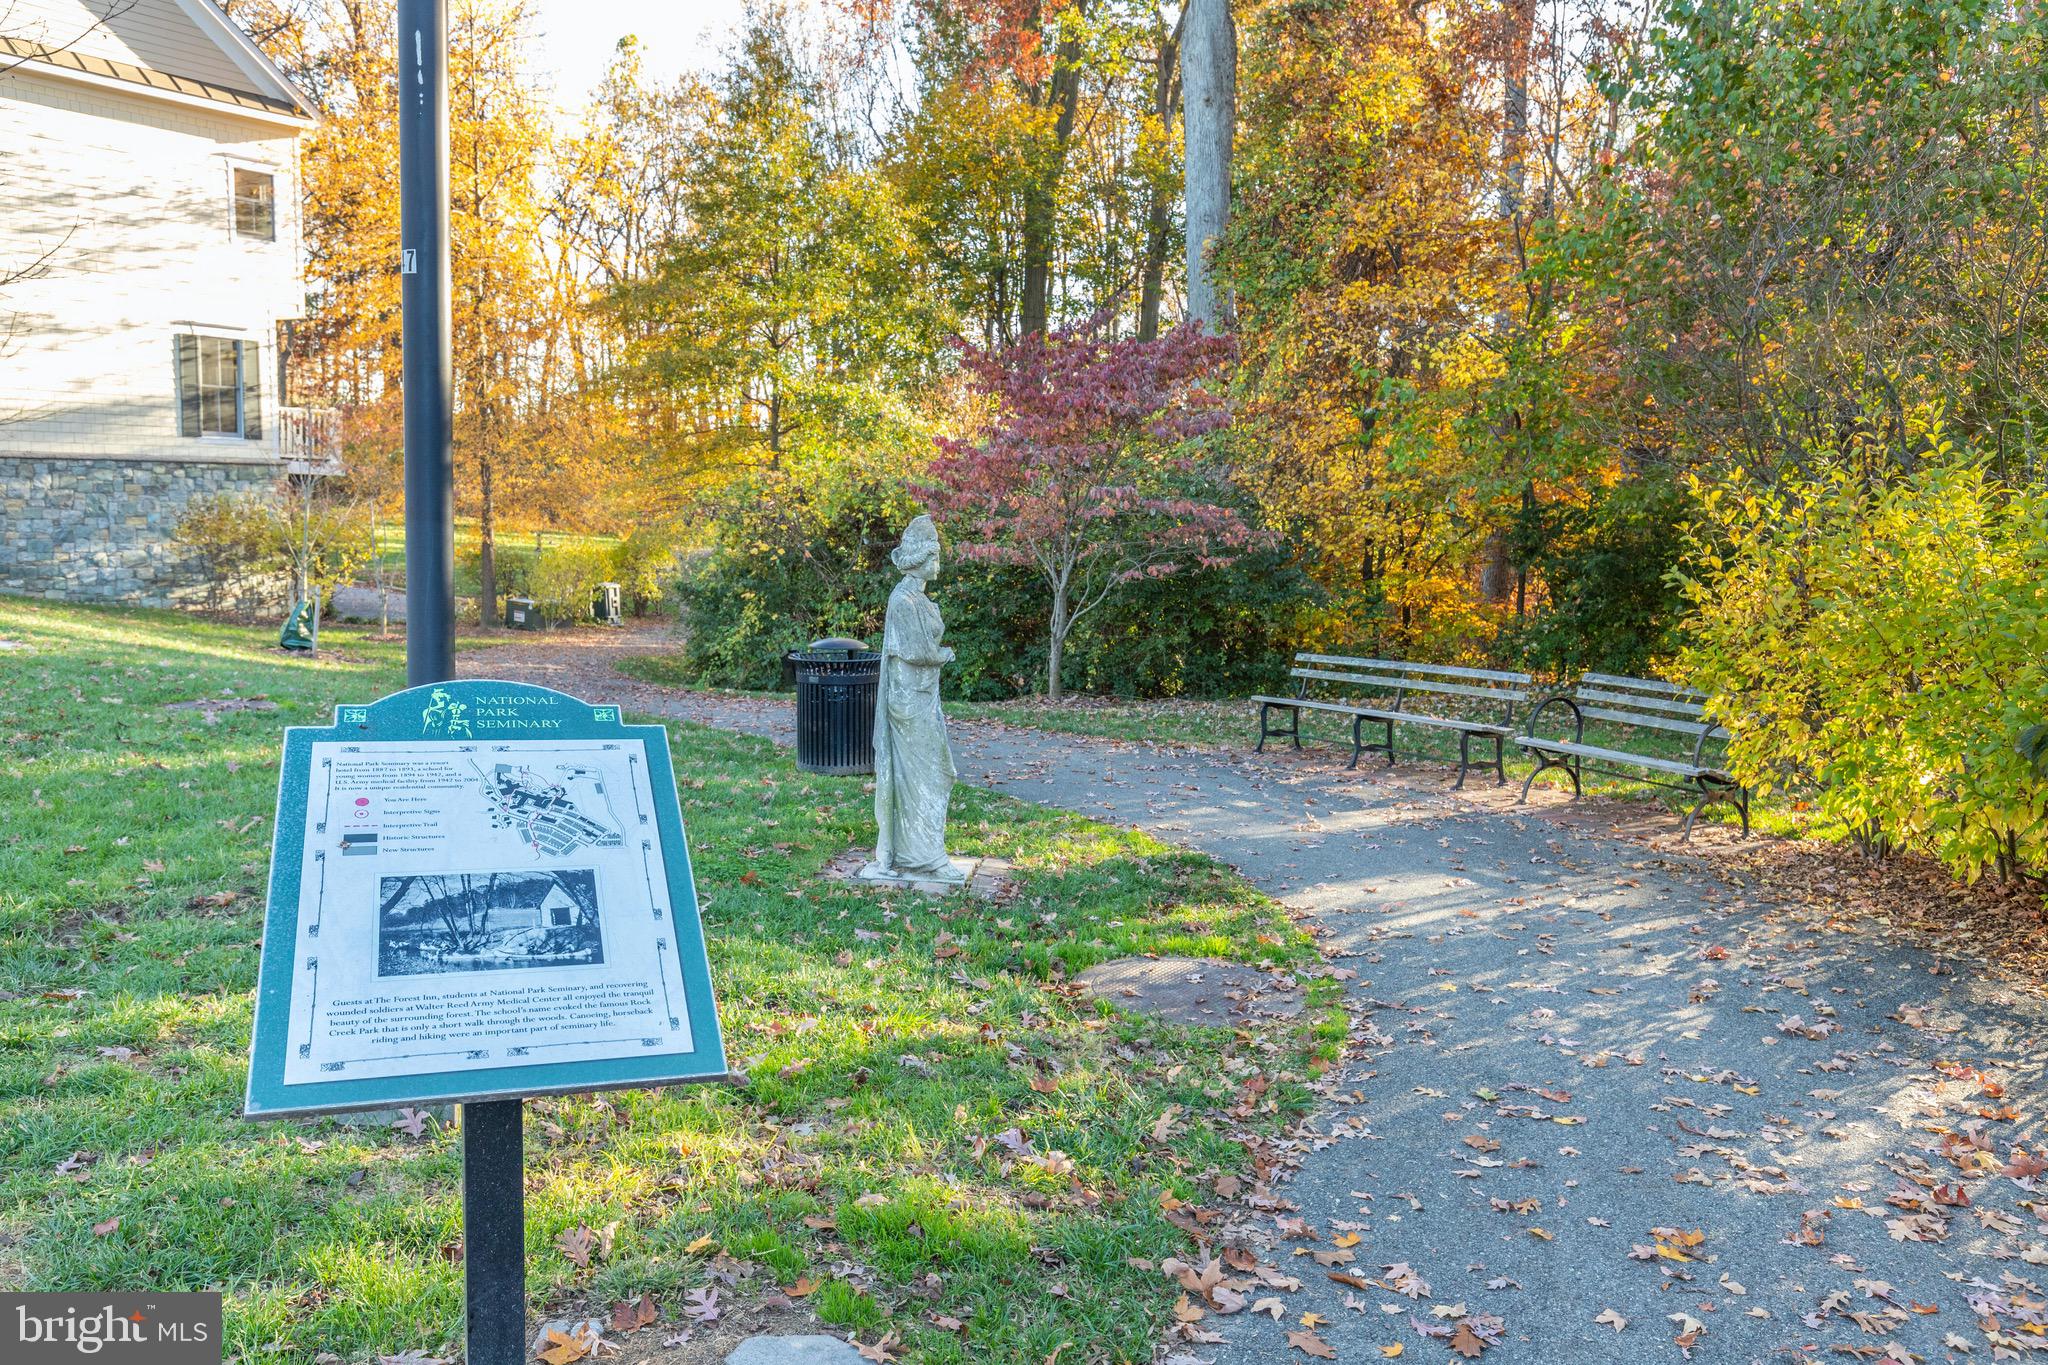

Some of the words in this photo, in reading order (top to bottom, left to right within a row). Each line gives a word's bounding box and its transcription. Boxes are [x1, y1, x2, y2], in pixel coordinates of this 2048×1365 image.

[476, 720, 562, 728] SEMINARY
[477, 708, 519, 716] PARK
[326, 1008, 366, 1016] wounded
[575, 993, 606, 1001] enjoyed
[623, 989, 654, 997] tranquil
[442, 992, 477, 1000] students
[548, 985, 587, 993] Seminary,
[606, 981, 648, 989] recovering
[330, 1019, 359, 1027] beauty
[390, 1013, 444, 1022] surrounding
[446, 1011, 473, 1019] forest.
[600, 1000, 628, 1008] famous
[410, 1023, 430, 1032] only
[487, 1017, 520, 1026] through
[570, 1011, 611, 1020] Canoeing,
[613, 1008, 653, 1016] horseback
[371, 1036, 398, 1044] riding
[419, 1032, 446, 1041] hiking
[485, 1026, 527, 1036] important
[530, 1025, 547, 1034] part
[561, 1021, 597, 1031] seminary
[600, 1020, 616, 1028] life.
